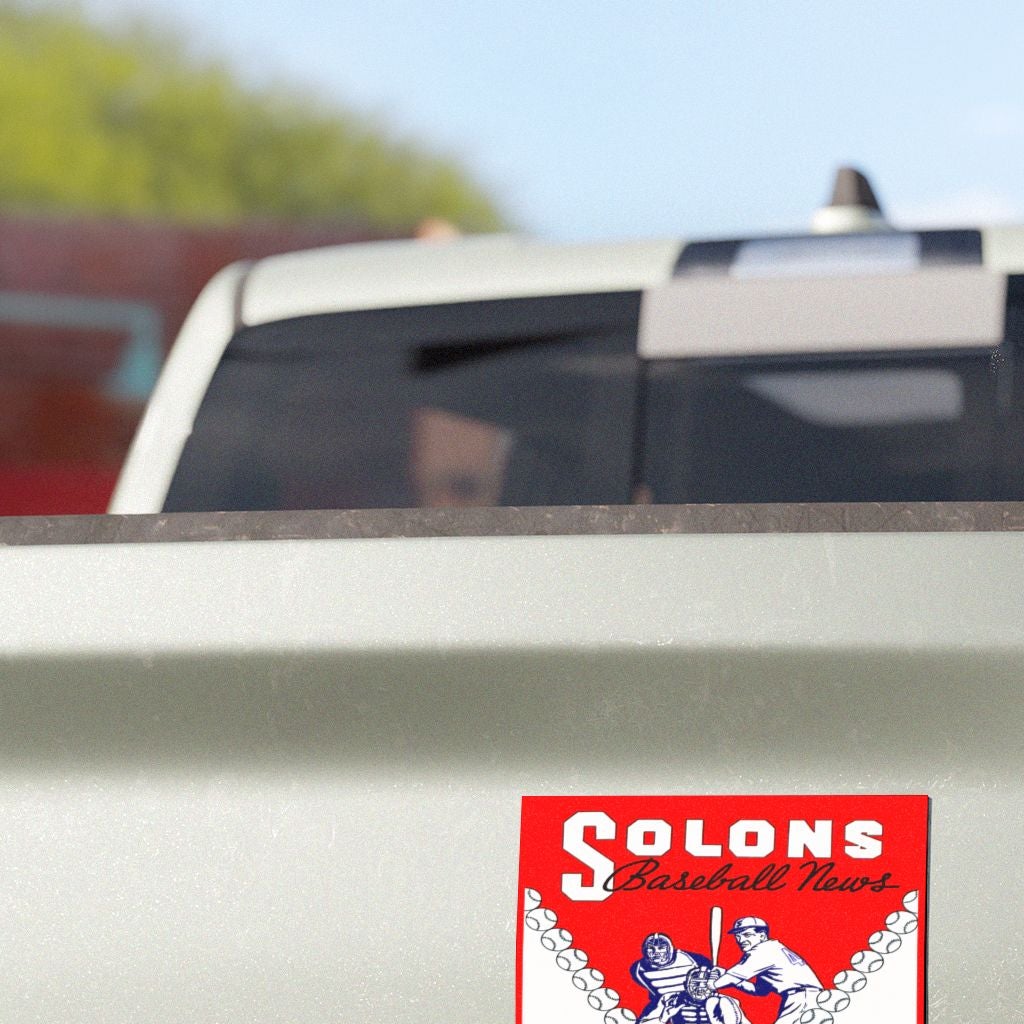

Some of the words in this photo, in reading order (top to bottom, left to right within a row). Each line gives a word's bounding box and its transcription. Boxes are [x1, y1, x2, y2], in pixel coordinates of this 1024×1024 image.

[561, 811, 883, 902] SOLONS
[602, 858, 790, 892] Baseball
[798, 861, 900, 892] News
